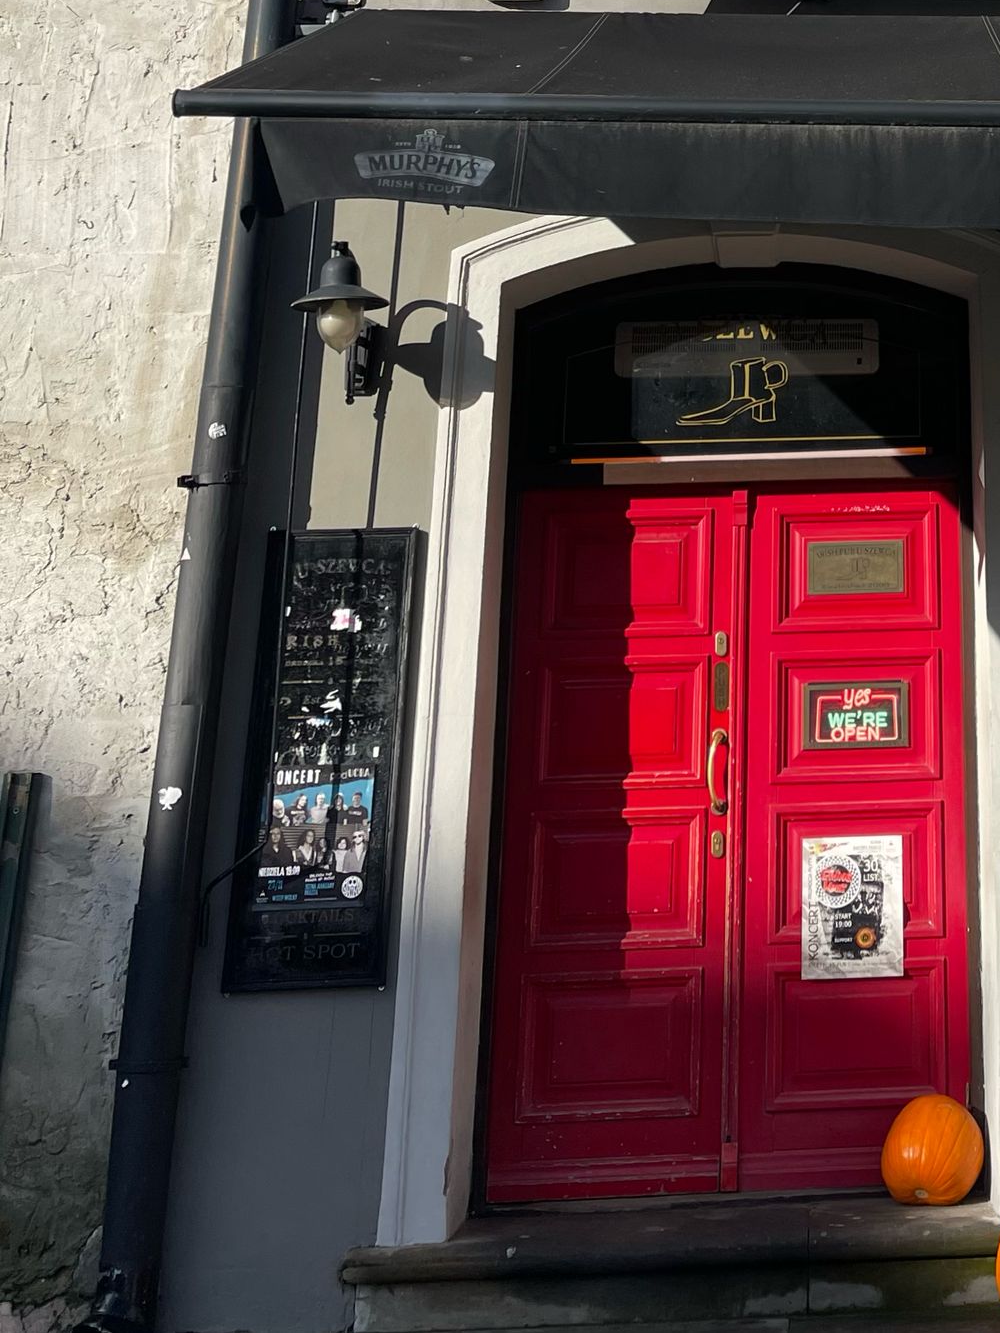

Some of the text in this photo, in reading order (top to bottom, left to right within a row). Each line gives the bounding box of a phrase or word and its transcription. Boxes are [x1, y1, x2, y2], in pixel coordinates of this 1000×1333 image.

[377, 178, 465, 194] IRISH STOUT
[828, 710, 888, 728] WE'RE
[831, 727, 880, 742] OPEN
[863, 860, 878, 873] 30
[808, 901, 819, 960] KONCERT
[303, 942, 361, 960] SPOT
